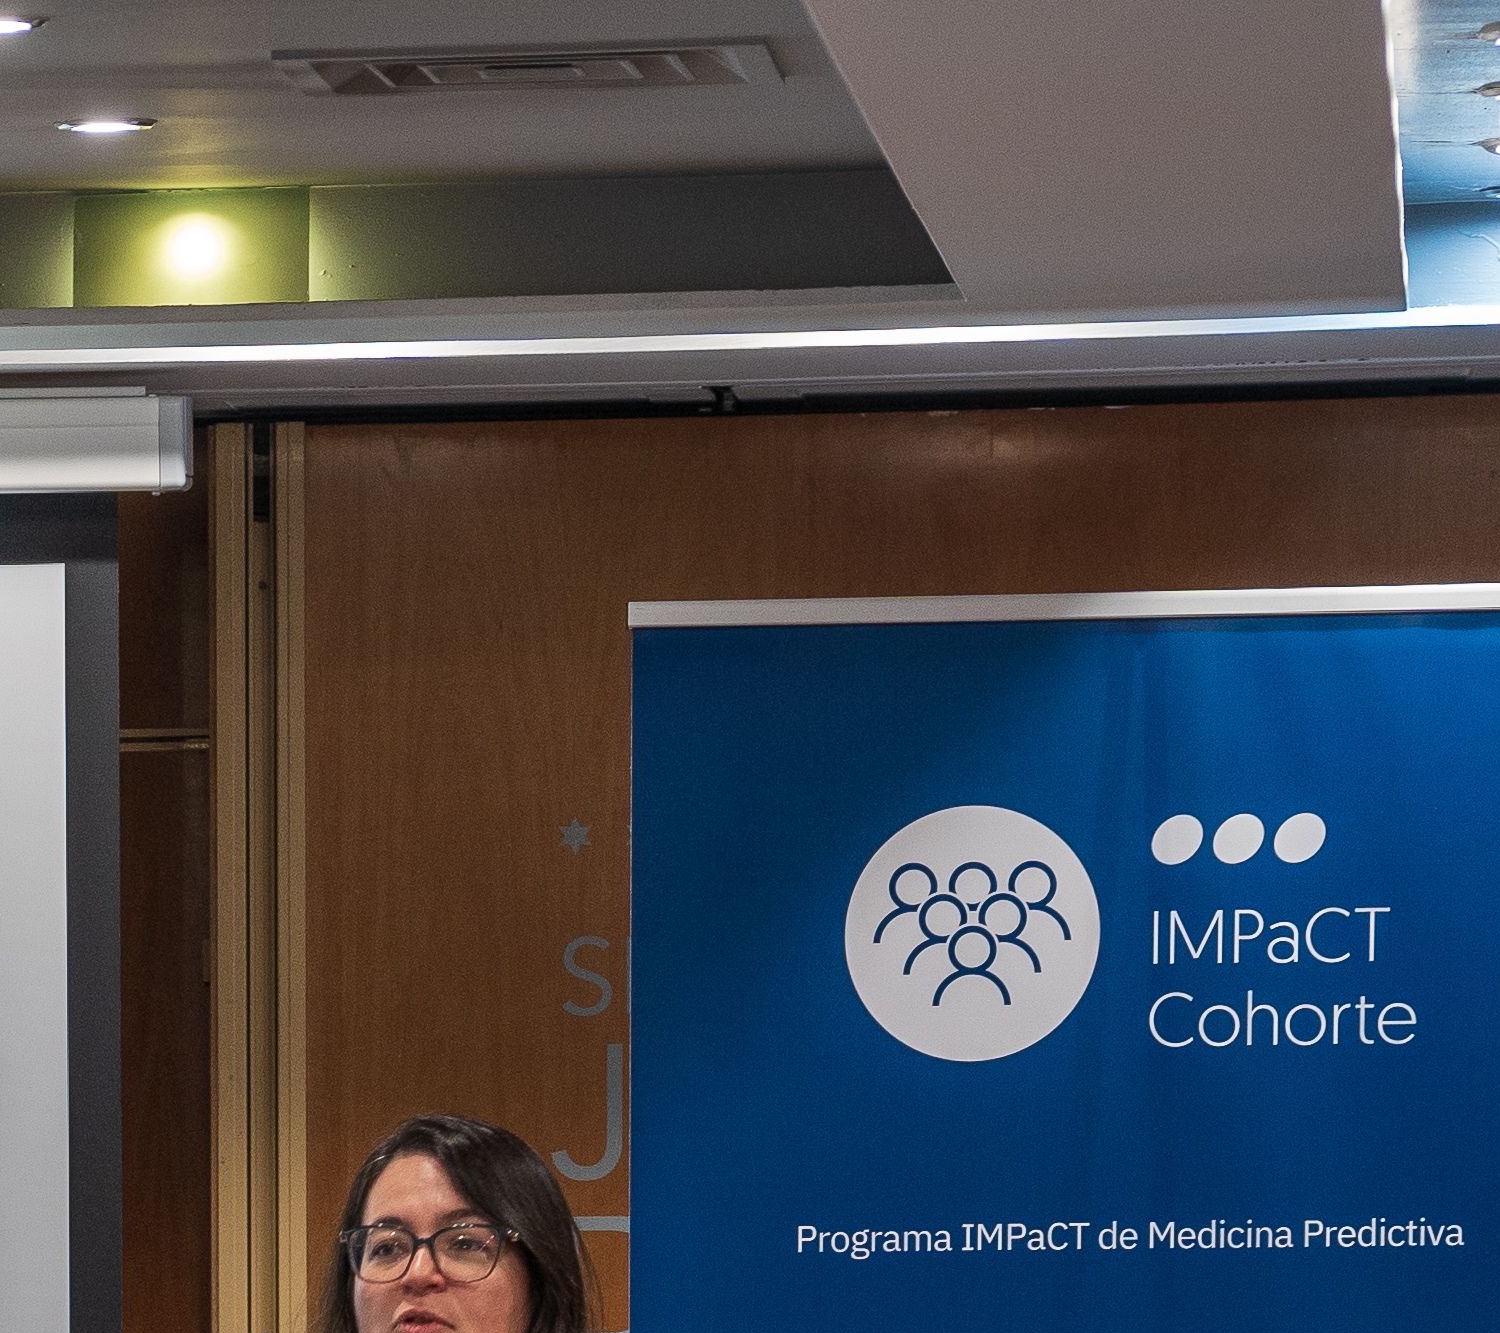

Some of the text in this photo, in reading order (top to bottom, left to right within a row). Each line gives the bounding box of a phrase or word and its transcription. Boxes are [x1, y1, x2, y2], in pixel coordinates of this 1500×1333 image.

[1150, 906, 1390, 965] IMPaCT
[1147, 990, 1417, 1049] Cohorte
[796, 1218, 1464, 1260] Programa IMPaCT de Medicina Predictiva
